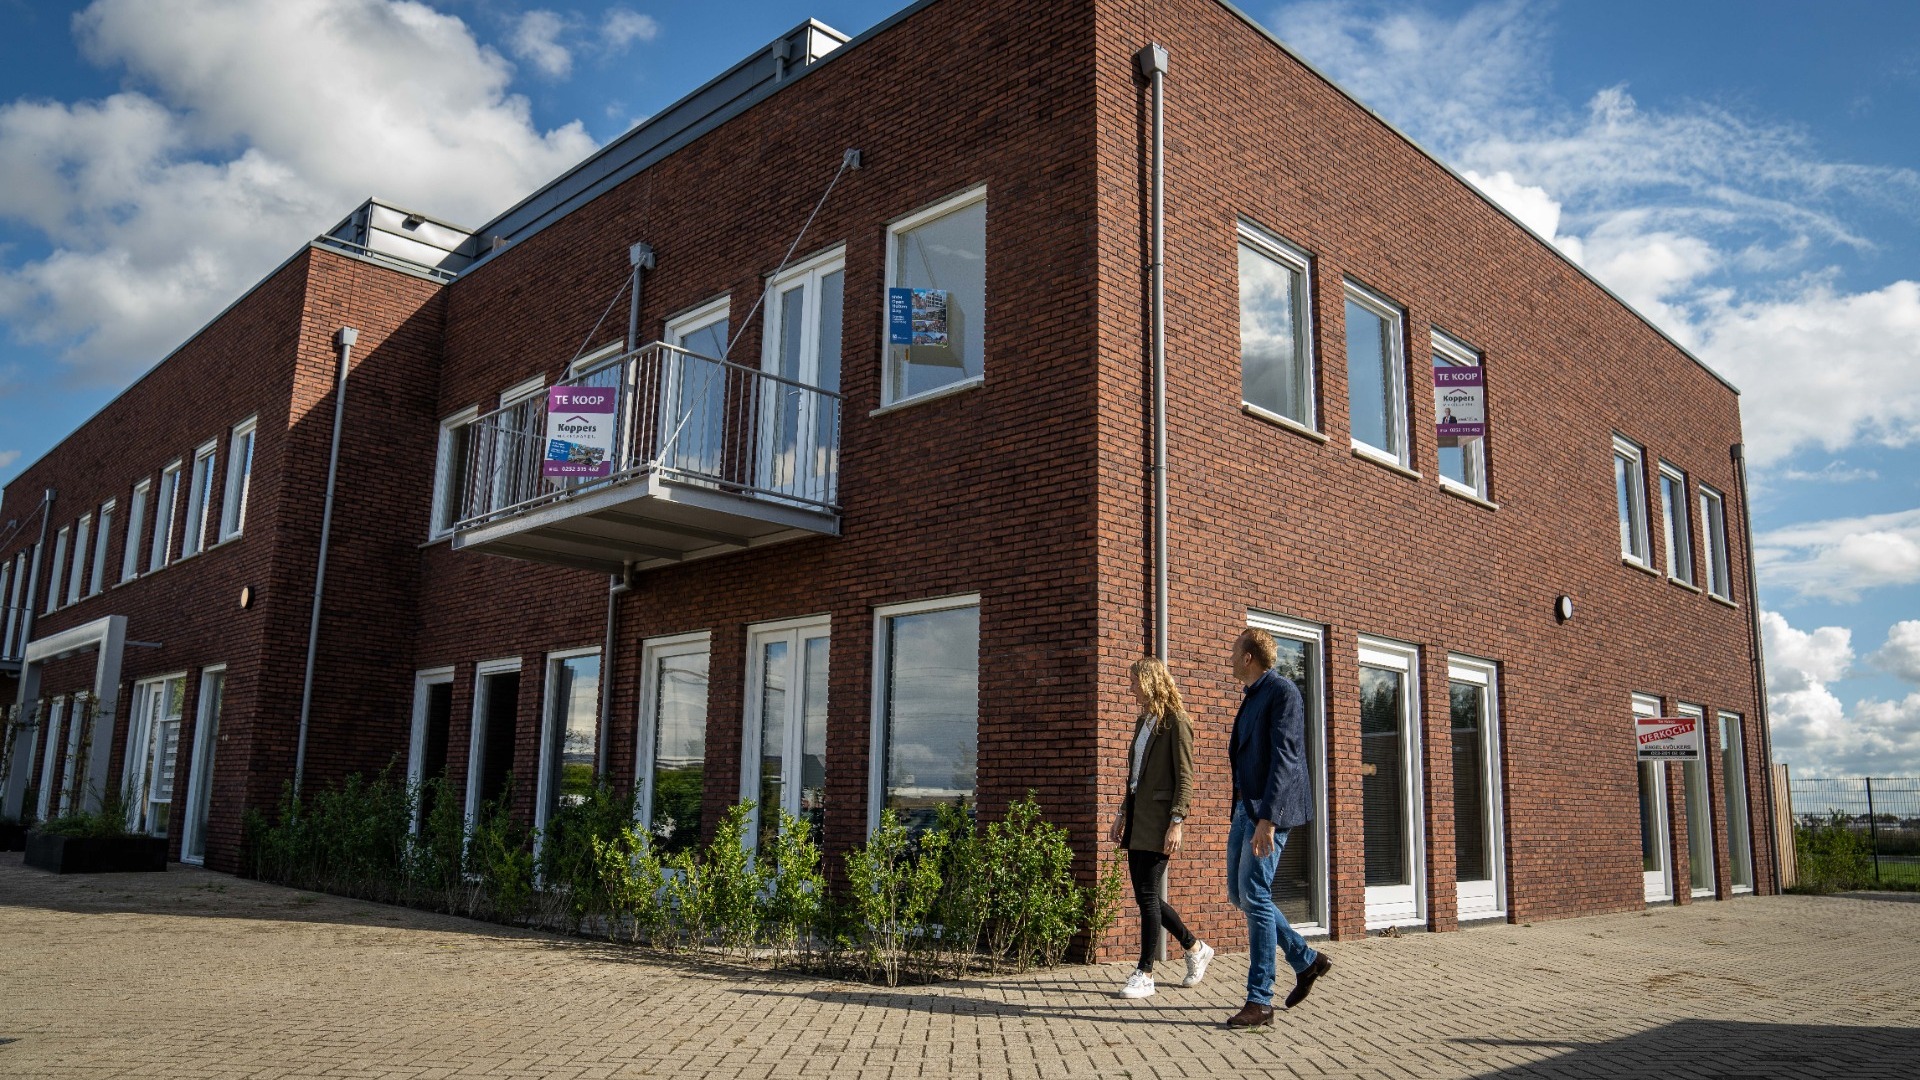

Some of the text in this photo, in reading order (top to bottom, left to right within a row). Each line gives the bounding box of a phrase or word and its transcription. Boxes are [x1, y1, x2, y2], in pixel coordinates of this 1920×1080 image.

[554, 395, 605, 405] TE KOOP
[557, 423, 597, 433] Koppers
[1641, 724, 1692, 743] VERKOCHT
